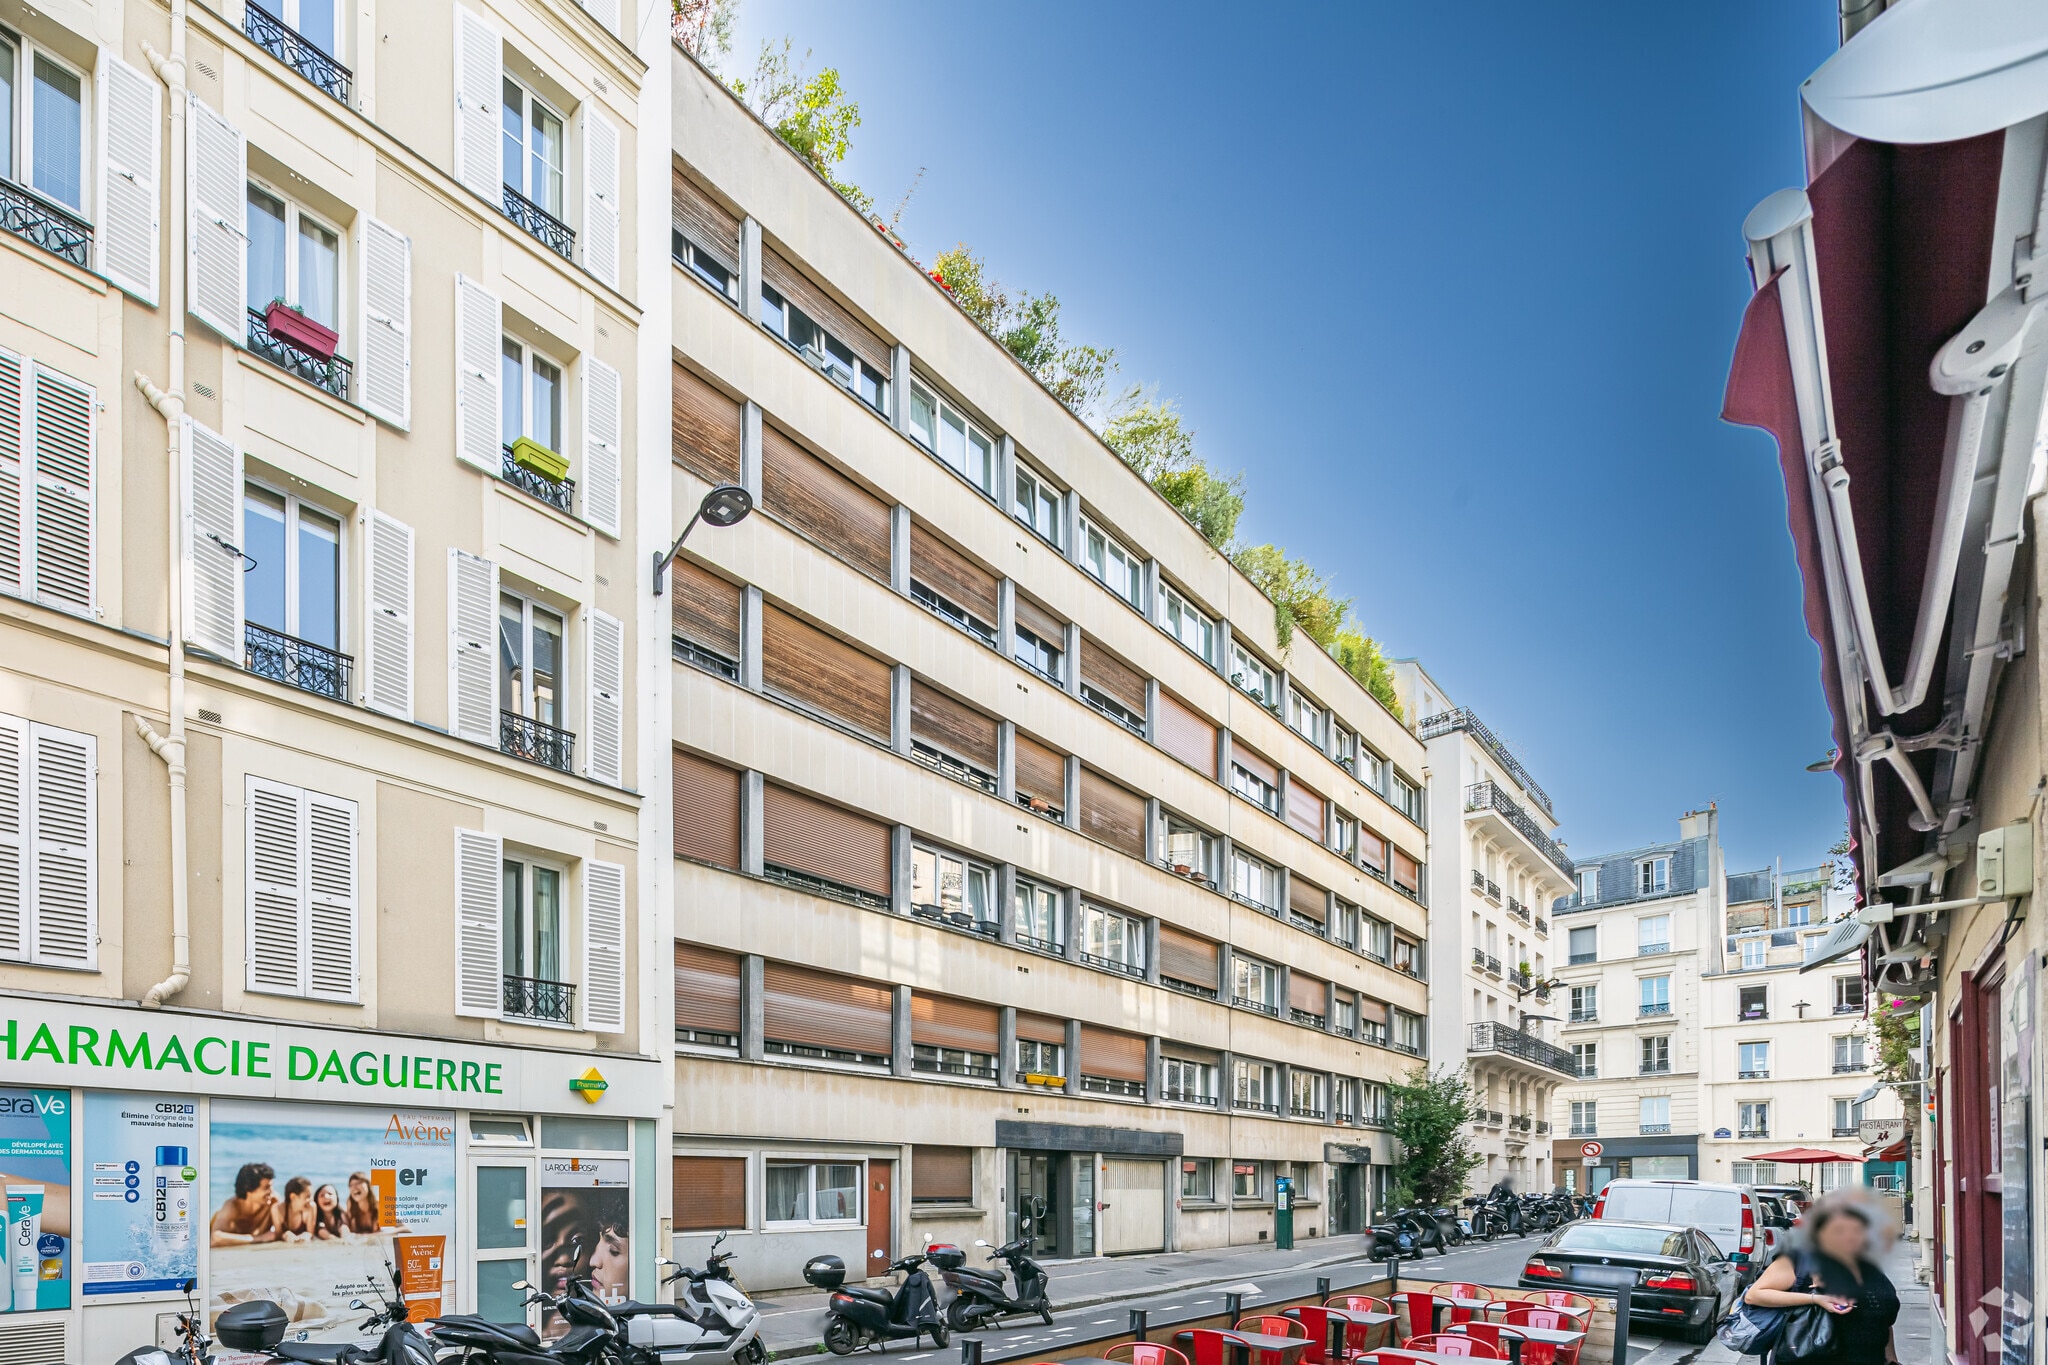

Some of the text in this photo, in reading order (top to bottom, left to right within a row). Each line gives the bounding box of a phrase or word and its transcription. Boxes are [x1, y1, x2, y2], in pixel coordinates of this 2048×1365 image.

[288, 1046, 503, 1094] DAGUERRE
[576, 1080, 607, 1089] PharmaVie
[155, 1103, 184, 1114] CB12
[121, 1110, 149, 1119] Élimine
[130, 1120, 194, 1129] mauvaise haleine
[384, 1113, 452, 1141] Avène
[1860, 1120, 1903, 1130] RESTAURANT
[11, 1140, 47, 1148] DÉVELOPPÉ
[370, 1158, 397, 1167] Notre
[544, 1164, 553, 1172] LA
[155, 1187, 167, 1222] CB12
[18, 1205, 32, 1247] CeraVe
[411, 1248, 434, 1256] Avène
